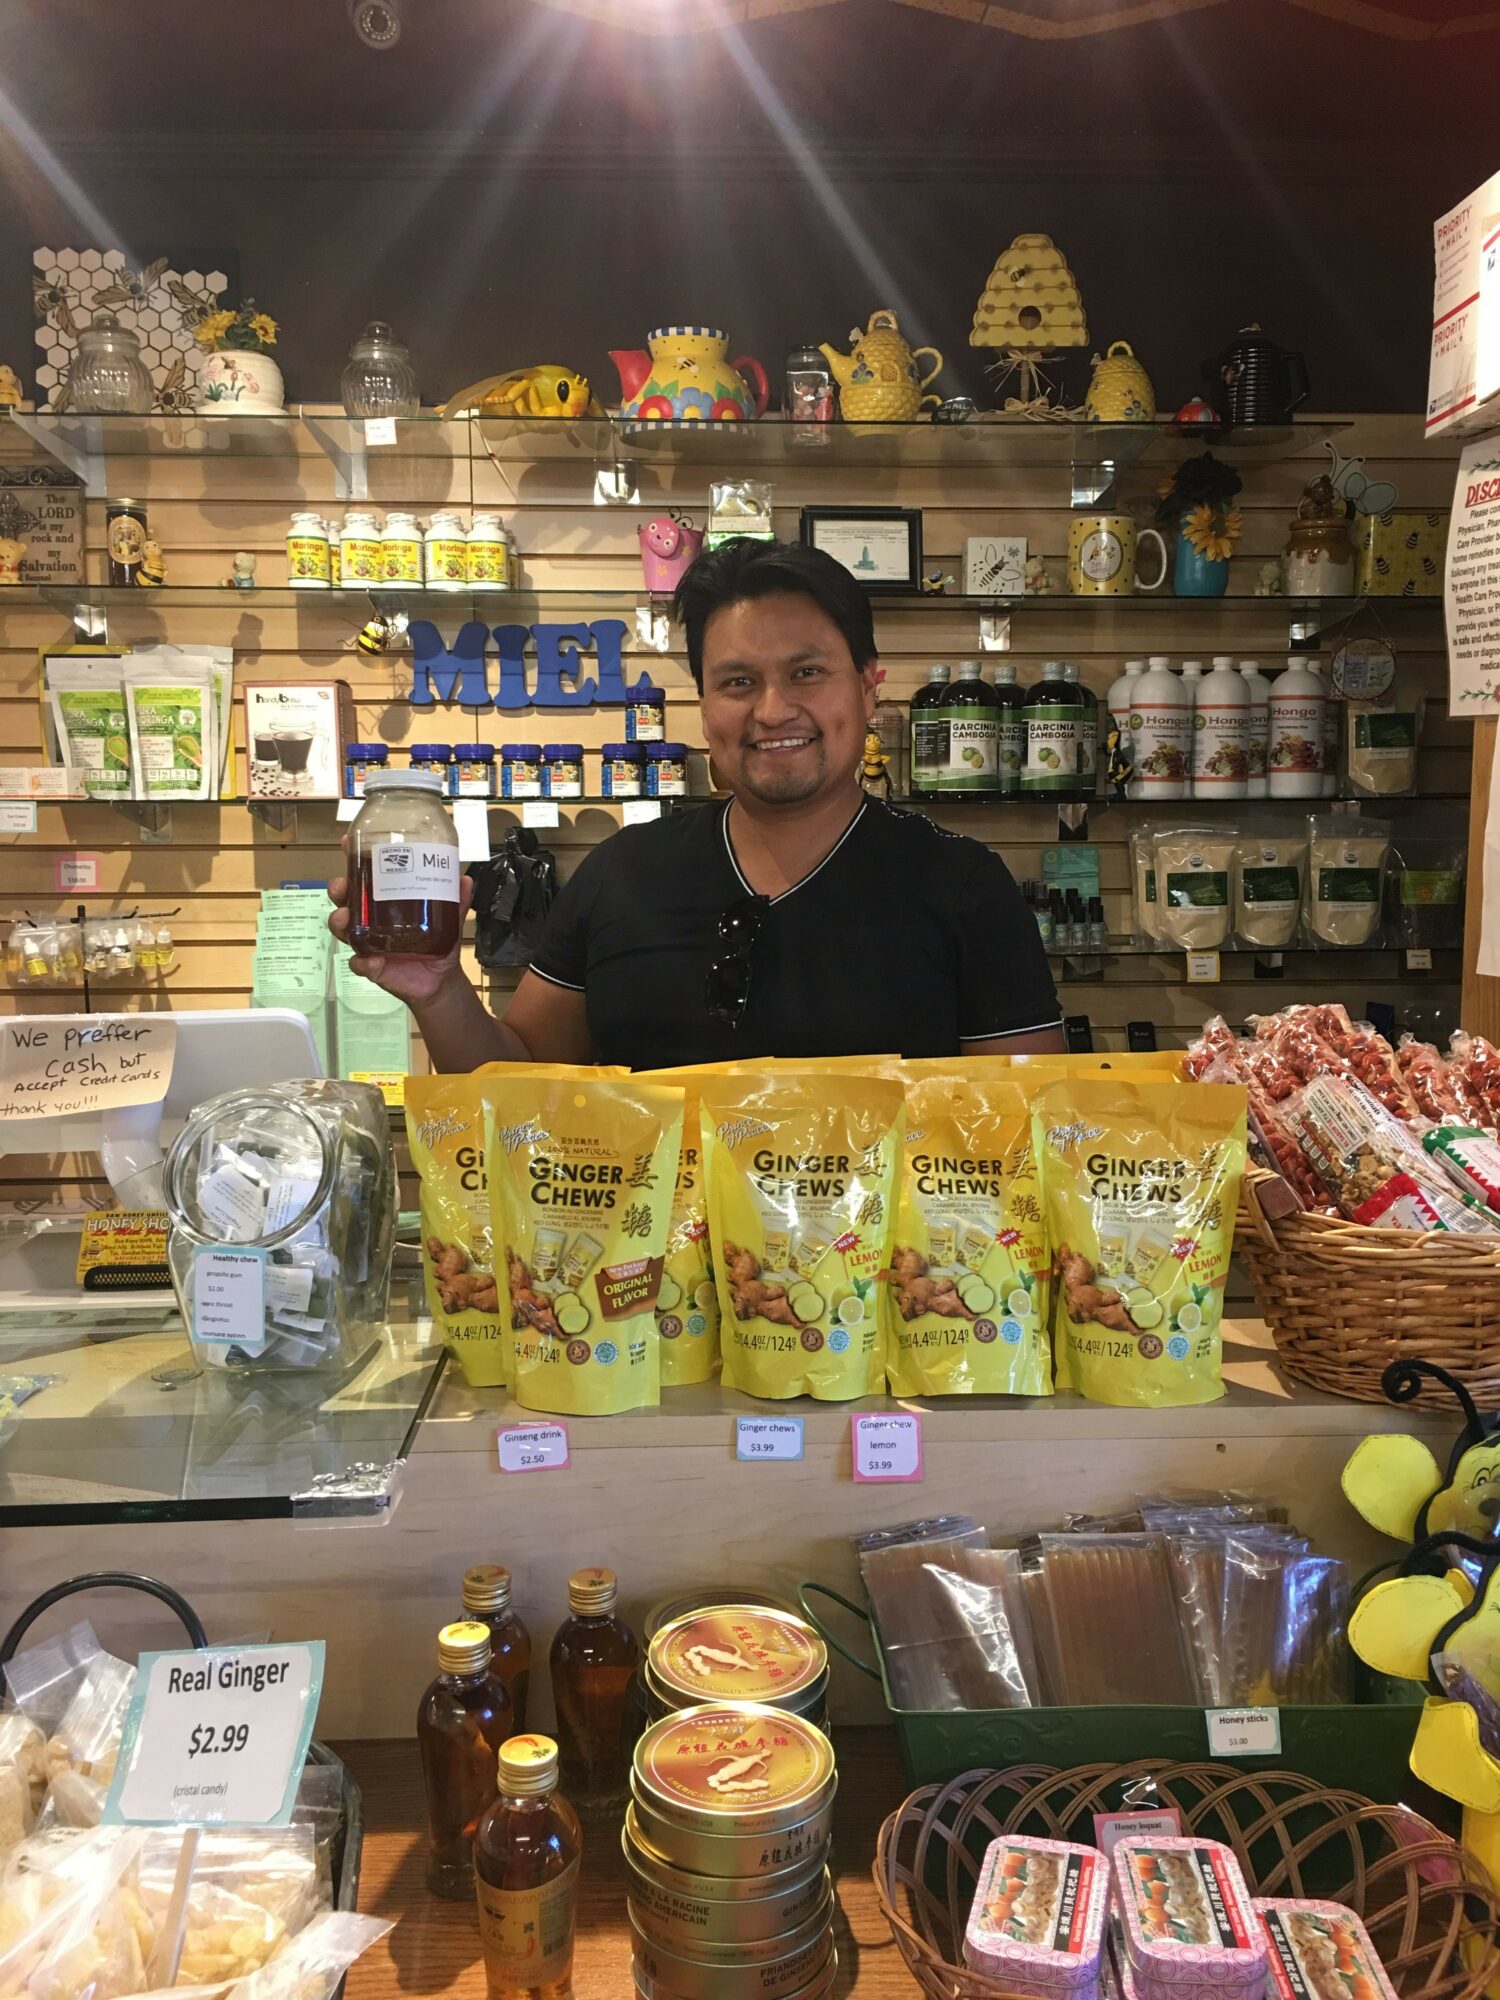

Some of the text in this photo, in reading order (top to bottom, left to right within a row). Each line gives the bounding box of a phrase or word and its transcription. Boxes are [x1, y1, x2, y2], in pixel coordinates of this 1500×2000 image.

[1437, 206, 1472, 241] PRIORITY
[1445, 230, 1463, 250] MAIL
[1434, 314, 1468, 346] PRIORITY
[1440, 338, 1457, 356] MAIL
[46, 494, 66, 504] The
[38, 507, 75, 519] LORD
[50, 524, 64, 533] my
[31, 534, 74, 543] rock and
[1457, 534, 1495, 549] Care Provider
[292, 541, 324, 552] Moringa
[439, 543, 466, 553] Moring
[470, 545, 500, 554] Moringa
[47, 550, 62, 560] my
[1468, 548, 1494, 560] remedies
[19, 560, 77, 572] Salvation
[1451, 575, 1498, 593] by anyone in this
[1456, 592, 1488, 604] Health Care
[1487, 606, 1494, 614] or
[1456, 621, 1488, 634] provide you
[1459, 635, 1470, 645] safe
[1471, 634, 1482, 644] and
[1456, 650, 1473, 659] needs
[406, 619, 655, 709] MIEL
[1272, 707, 1316, 717] Hongo
[139, 715, 174, 724] ORINGA
[953, 723, 996, 731] GARCINIA
[1030, 723, 1075, 731] GARCINIA
[953, 731, 996, 739] CAMBOGIA
[423, 853, 450, 868] Miel
[12, 1028, 48, 1048] We
[120, 1052, 147, 1069] but
[14, 1078, 68, 1093] Accept
[1309, 1096, 1324, 1115] ANTOJO
[715, 1117, 753, 1139] Prince
[573, 1147, 612, 1156] NATURAL
[753, 1150, 849, 1174] GINGER
[912, 1155, 1003, 1176] GINGER
[1087, 1153, 1187, 1179] GINGER
[529, 1157, 623, 1185] GINGER
[756, 1174, 845, 1197] CHEWS
[917, 1175, 1000, 1198] CHEWS
[1091, 1177, 1182, 1203] CHEWS
[531, 1182, 617, 1209] CHEWS
[87, 1218, 137, 1232] HONEY
[837, 1237, 856, 1250] NEW
[1001, 1231, 1018, 1244] NEW
[1013, 1246, 1045, 1260] LEMON
[1175, 1241, 1195, 1256] NEW
[213, 1255, 239, 1263] Healthy
[1188, 1254, 1222, 1273] LEMON
[603, 1273, 653, 1296] ORIGINAL
[612, 1287, 648, 1308] FLAVOR
[740, 1423, 796, 1434] Ginger chews
[860, 1419, 912, 1431] Ginger chew
[504, 1430, 562, 1443] Ginseng drink
[750, 1442, 774, 1452] $3.99
[870, 1440, 897, 1450] lemon
[521, 1454, 545, 1465] $2.50
[869, 1460, 892, 1470] $3.99
[168, 1660, 290, 1694] Real Ginger
[1219, 1714, 1269, 1725] Honey sticks
[188, 1723, 250, 1759] $2.99
[1229, 1737, 1248, 1746] $3.00
[173, 1782, 229, 1799] (cristal candy)
[665, 1776, 708, 1801] AMERICAN
[1114, 1821, 1162, 1833] Honey loquat
[658, 1891, 711, 1917] LA RACINE
[653, 1902, 708, 1926] AMERICAIN
[763, 1975, 778, 1987] DE
